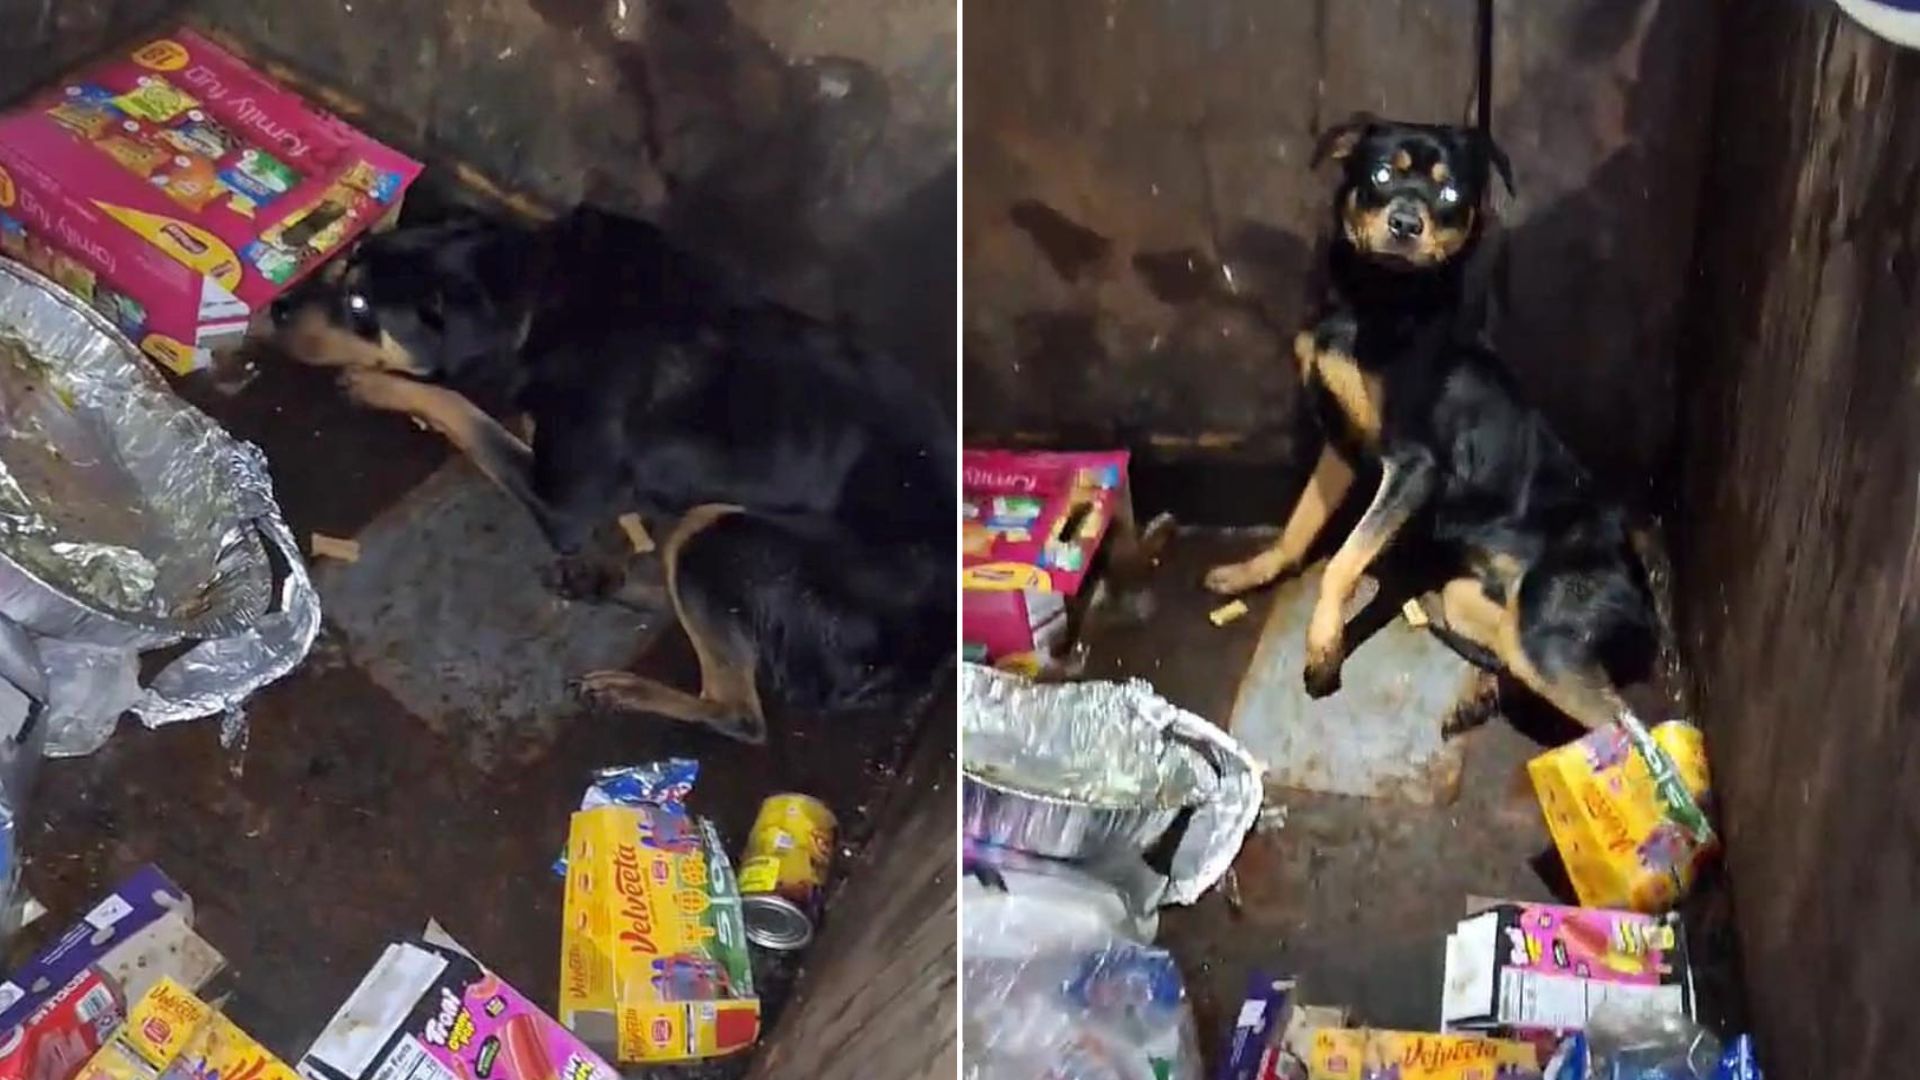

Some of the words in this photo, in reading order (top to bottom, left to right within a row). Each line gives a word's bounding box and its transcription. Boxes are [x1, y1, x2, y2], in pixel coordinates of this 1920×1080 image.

[184, 66, 229, 101] fun
[613, 844, 658, 954] Velveeta
[425, 987, 461, 1045] Trolli
